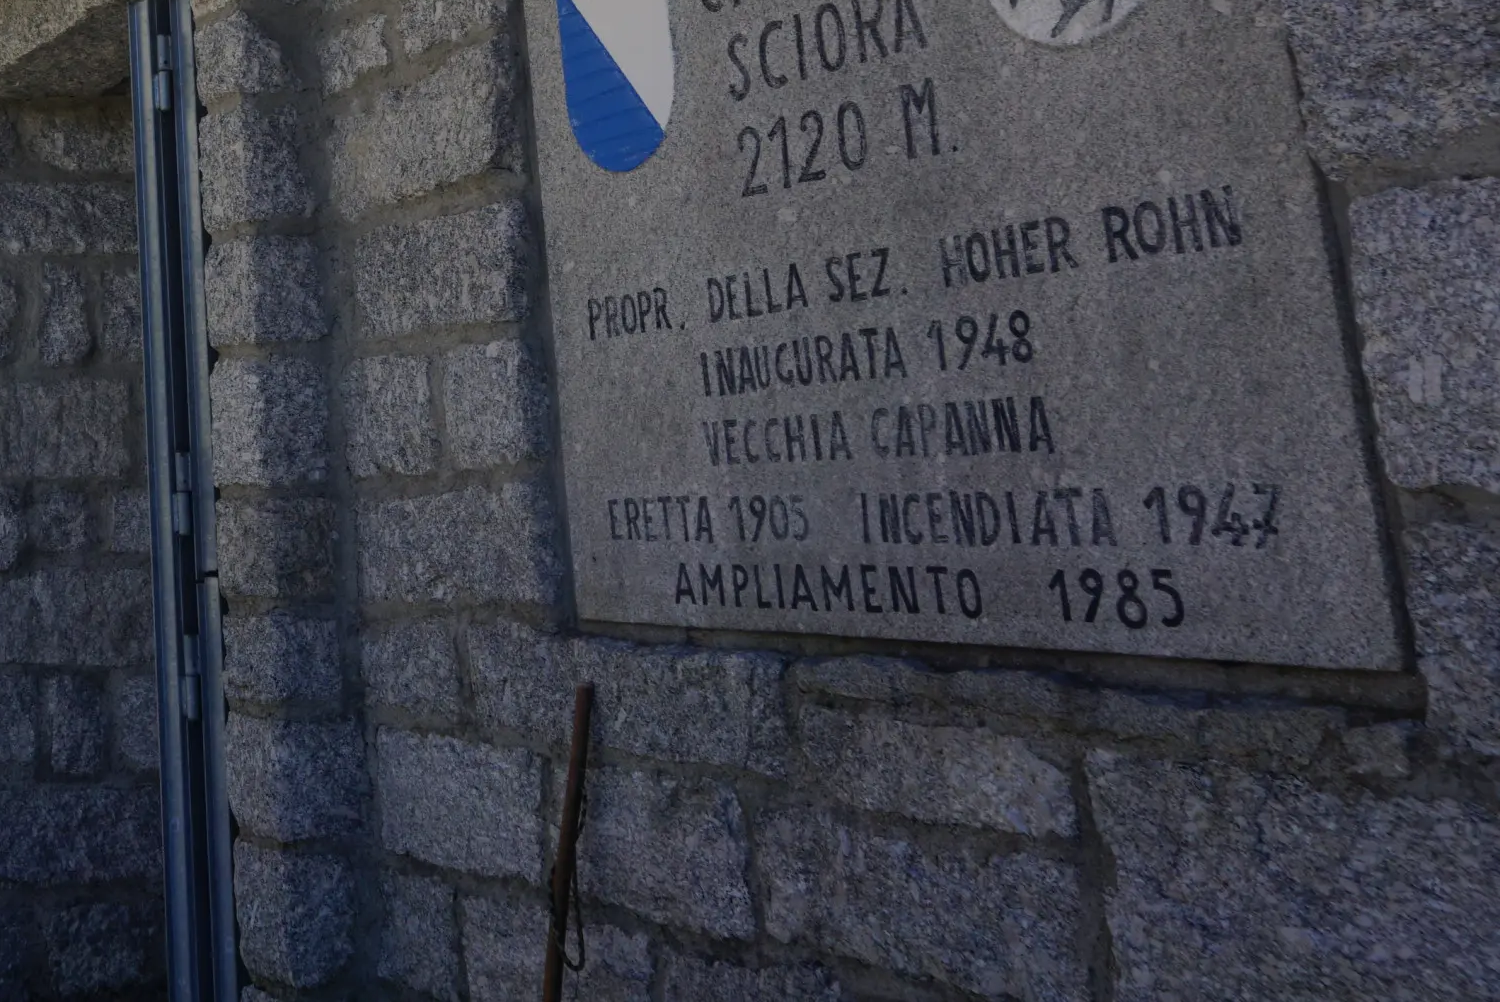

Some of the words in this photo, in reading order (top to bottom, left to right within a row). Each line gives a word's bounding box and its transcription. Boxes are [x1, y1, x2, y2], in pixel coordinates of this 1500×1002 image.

[736, 100, 868, 198] 2120
[902, 77, 961, 160] M.
[588, 286, 687, 341] PROPR.
[707, 262, 808, 324] DELLA
[825, 246, 908, 304] SEZ.
[939, 215, 1080, 288] HOHER
[1103, 184, 1244, 264] ROHN
[701, 325, 907, 398] INAUGURATA
[926, 309, 1035, 372] 1948
[703, 409, 853, 466] VECCHIA
[870, 395, 1055, 458] CAPANNA
[607, 496, 713, 543] ERETTA
[728, 496, 810, 544] 1905
[860, 486, 1119, 548] INCENDIATA
[675, 561, 983, 620] AMPLIAMENTO
[1047, 568, 1186, 631] 1985
